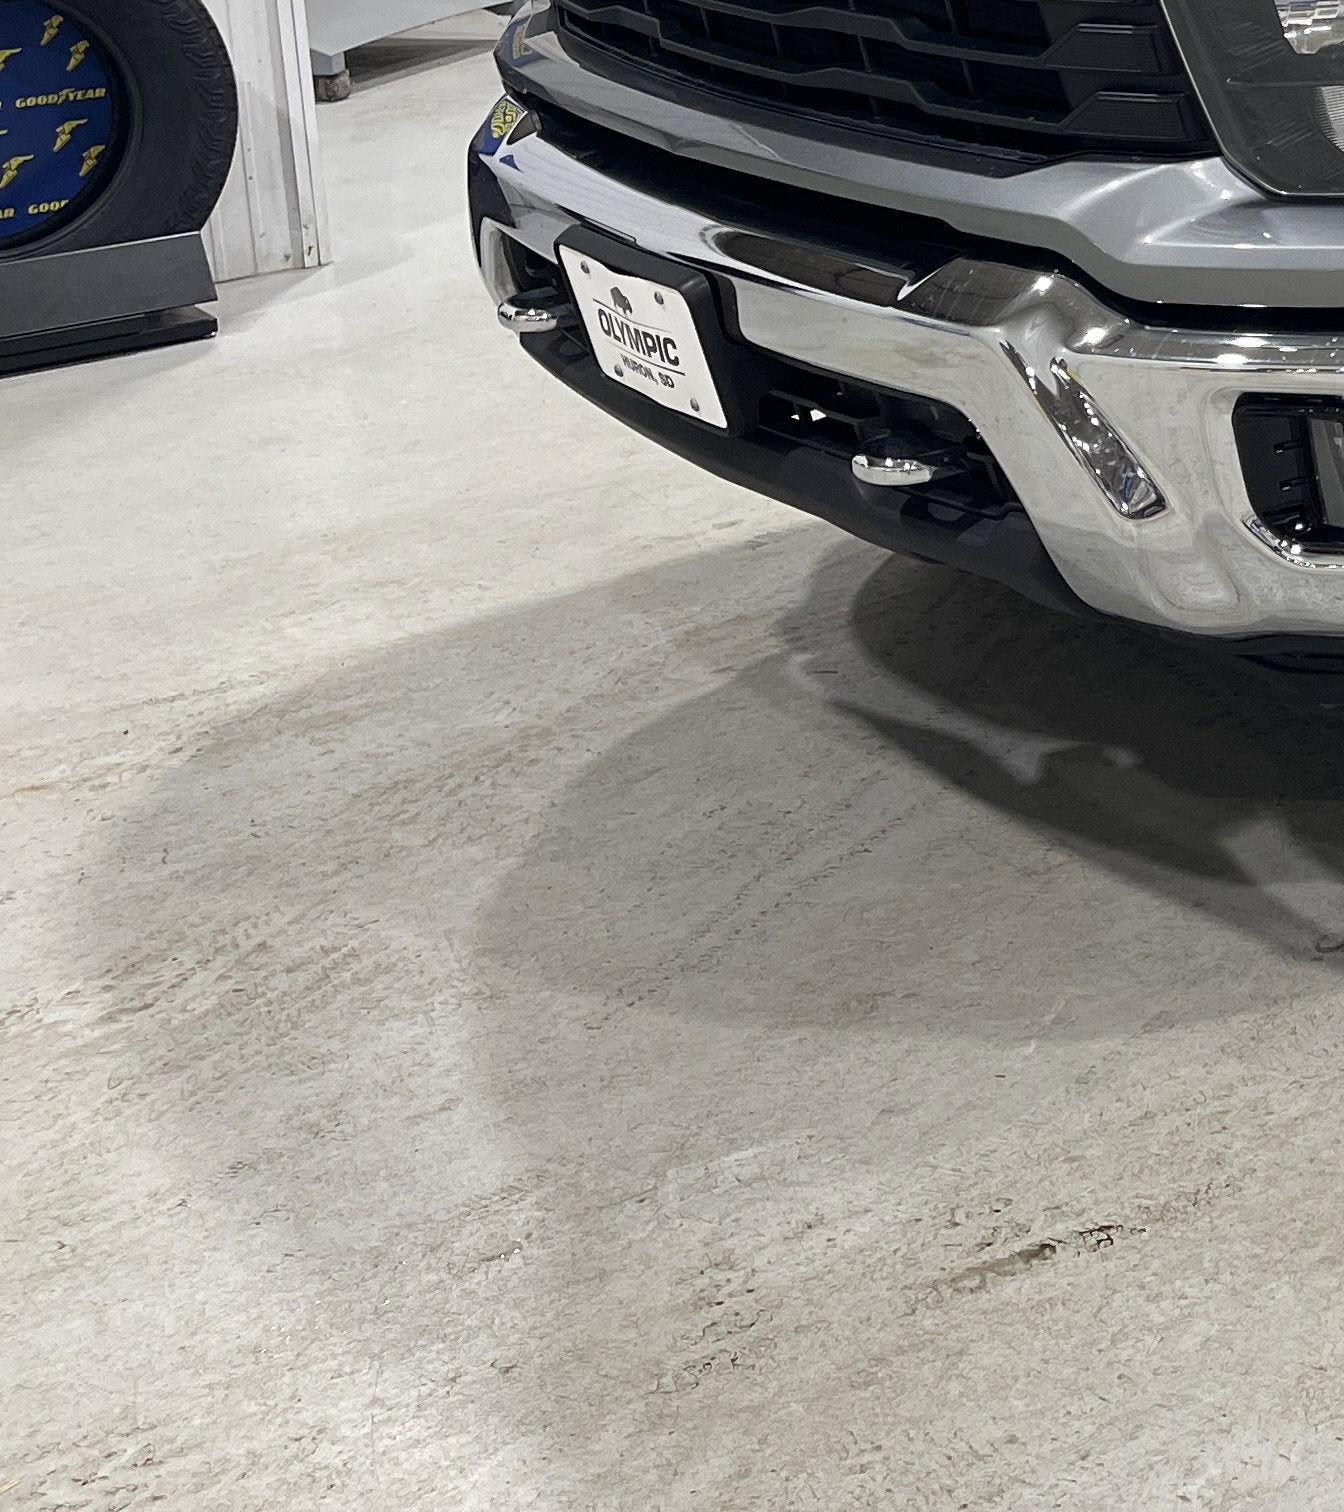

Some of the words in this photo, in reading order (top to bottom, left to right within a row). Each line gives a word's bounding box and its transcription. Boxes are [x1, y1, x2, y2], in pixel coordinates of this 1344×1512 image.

[597, 307, 680, 367] OLYMPIC
[621, 352, 659, 386] HURON,
[658, 371, 675, 389] SD
